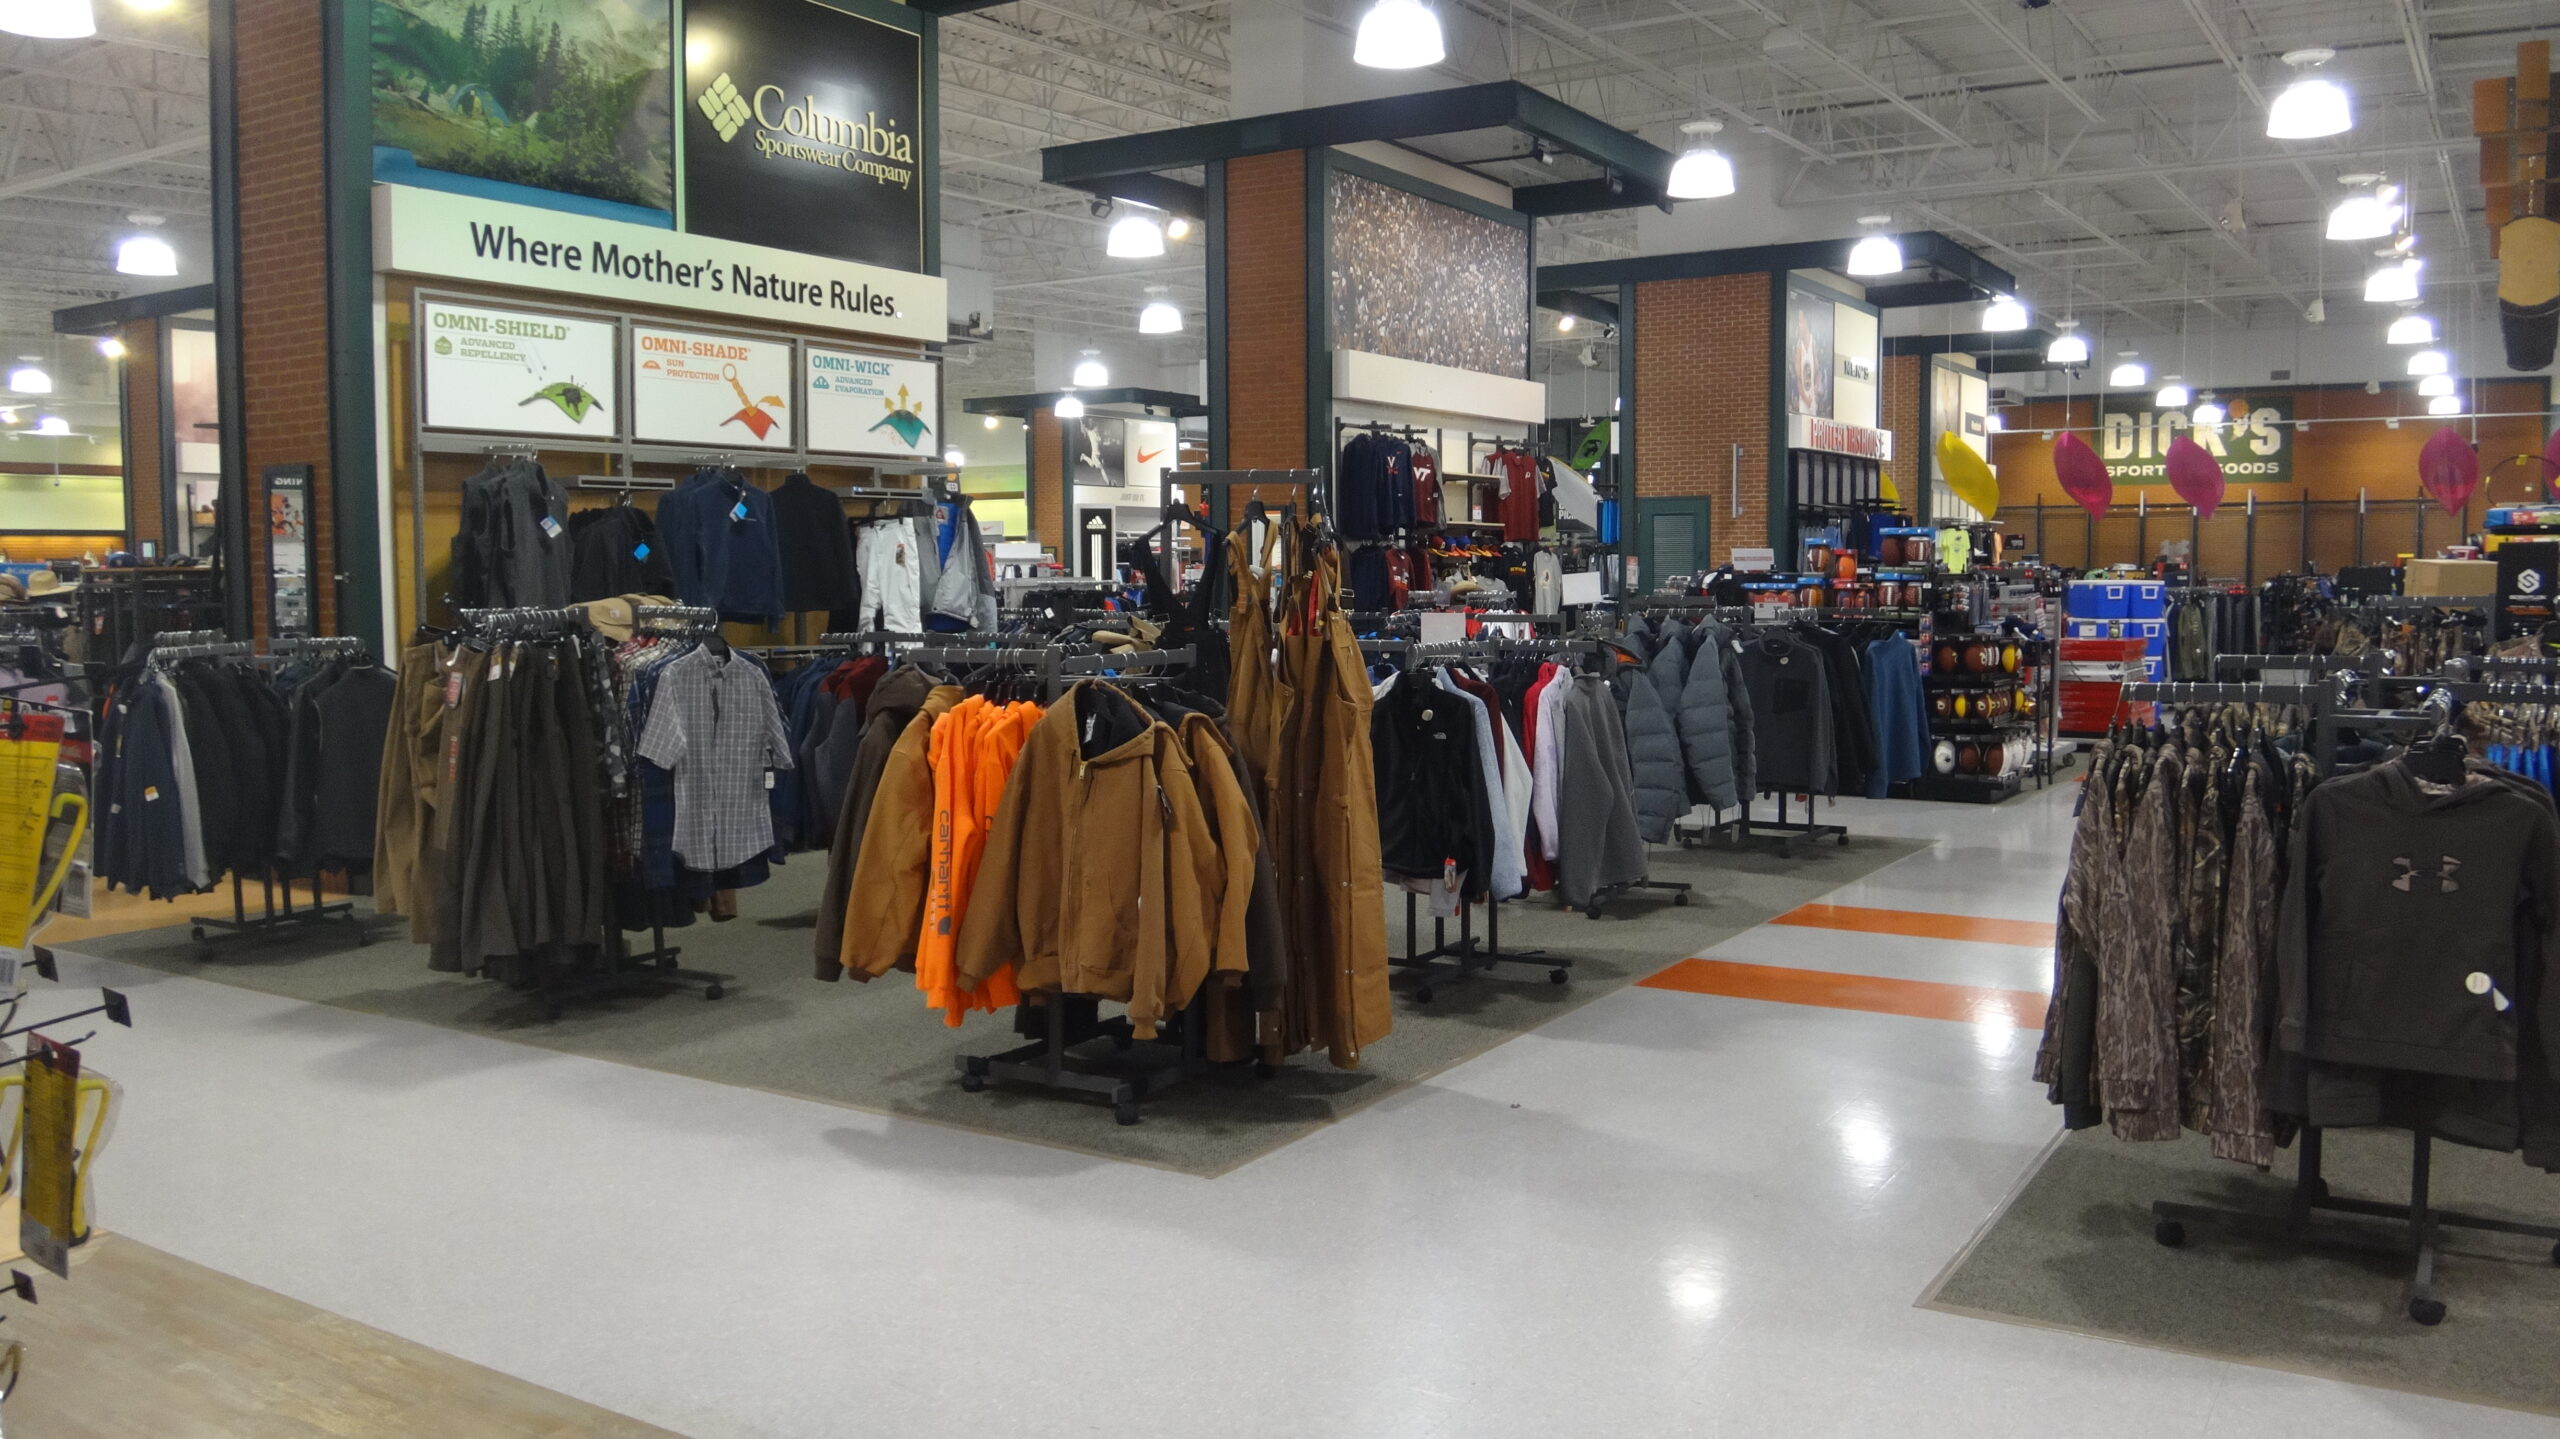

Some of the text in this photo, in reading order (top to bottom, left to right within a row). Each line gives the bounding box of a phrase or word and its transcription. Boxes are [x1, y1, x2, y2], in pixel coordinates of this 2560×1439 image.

[752, 84, 914, 164] Columbia
[754, 129, 913, 190] Sportswear Company
[469, 221, 583, 272] Where
[591, 240, 725, 293] Mother's
[731, 264, 824, 308] Nature
[460, 336, 516, 350] ADVANCED
[460, 348, 527, 363] REPELLENCY
[666, 358, 685, 368] SUN
[666, 368, 720, 381] PROTECTION
[835, 375, 873, 386] ADVANCED
[835, 384, 885, 397] EVAPORATION
[2103, 407, 2282, 460] DICK'S
[937, 809, 953, 912] carhartt
